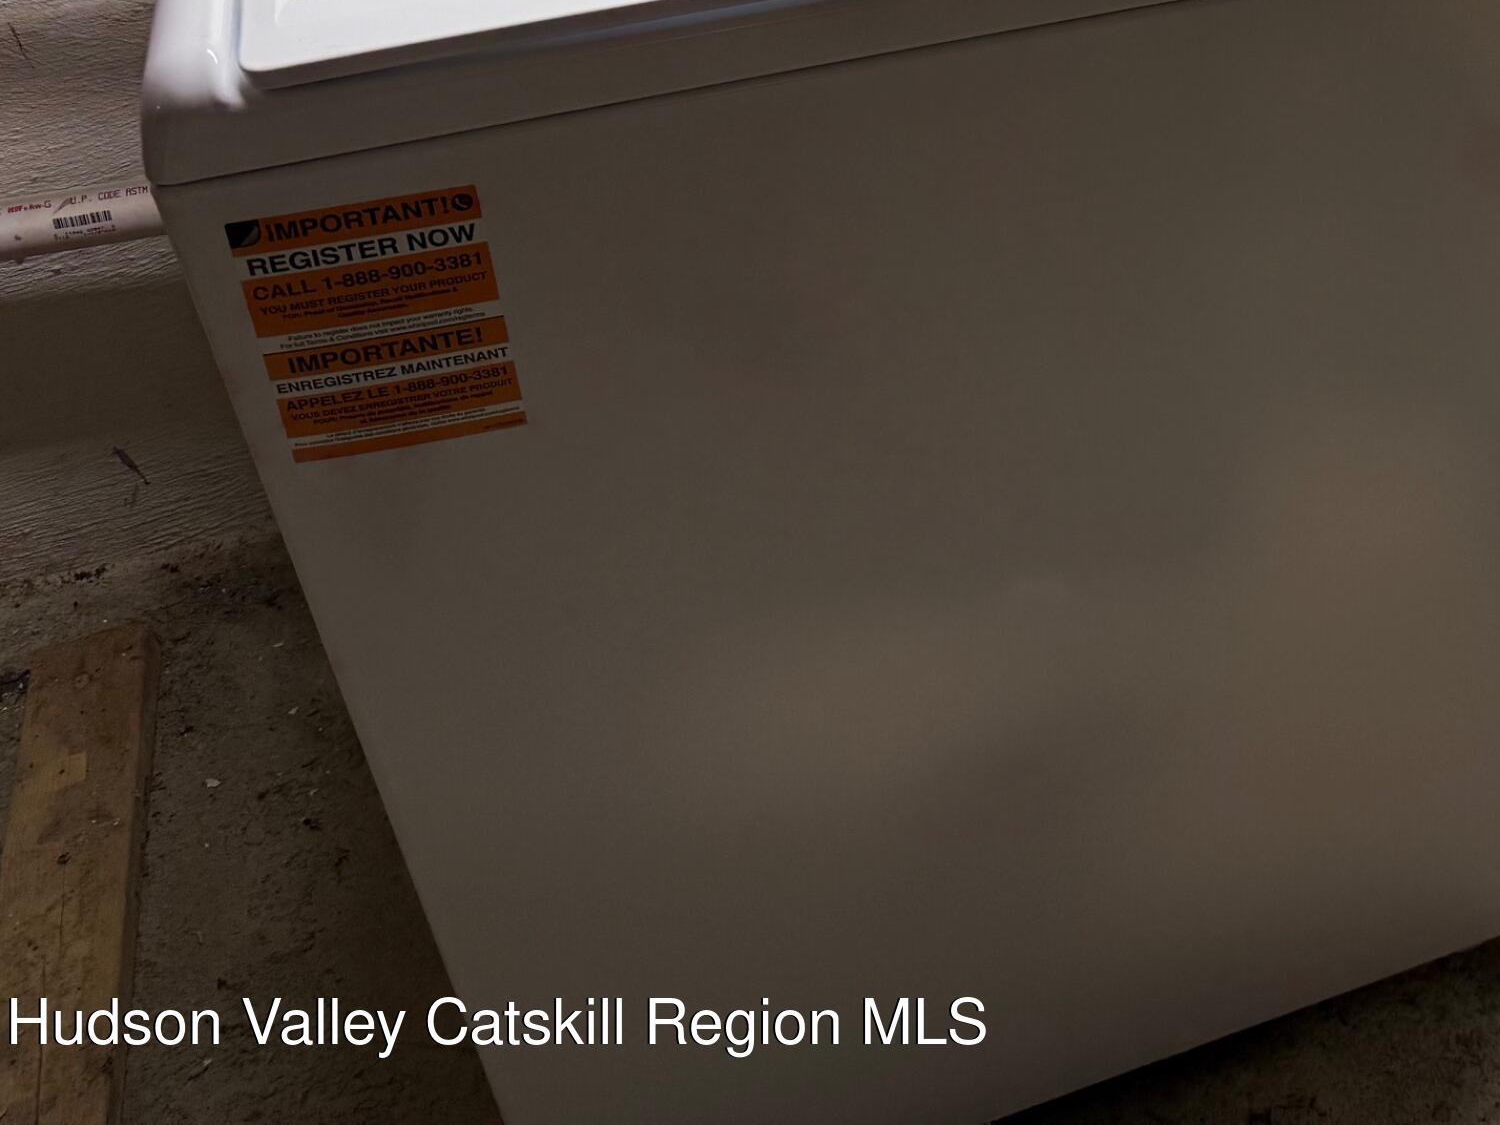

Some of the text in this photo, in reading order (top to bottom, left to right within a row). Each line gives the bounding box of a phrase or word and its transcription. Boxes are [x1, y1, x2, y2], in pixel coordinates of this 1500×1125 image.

[98, 189, 121, 201] CODE
[126, 186, 149, 197] ASTM
[265, 196, 449, 242] IMPORTANT!
[247, 223, 475, 276] REGISTER NOW
[253, 279, 317, 301] CALL
[321, 251, 482, 291] 1-888-900-3381
[260, 305, 287, 315] YOU
[290, 299, 327, 312] MUST
[328, 287, 390, 306] REGISTER
[391, 282, 427, 295] YOUR
[430, 271, 488, 290] PRODUCT
[276, 346, 509, 394] ENREGISTREZ MAINTENANT
[288, 327, 483, 374] IMPORTANTE!
[287, 390, 363, 412] APPELEZ
[368, 386, 390, 399] LE
[393, 365, 508, 394] 1-888-900-3381
[291, 411, 320, 422] VOUS
[322, 405, 356, 417] DEVEZ
[432, 386, 467, 399] VOTRE
[470, 377, 513, 393] PRODUIT
